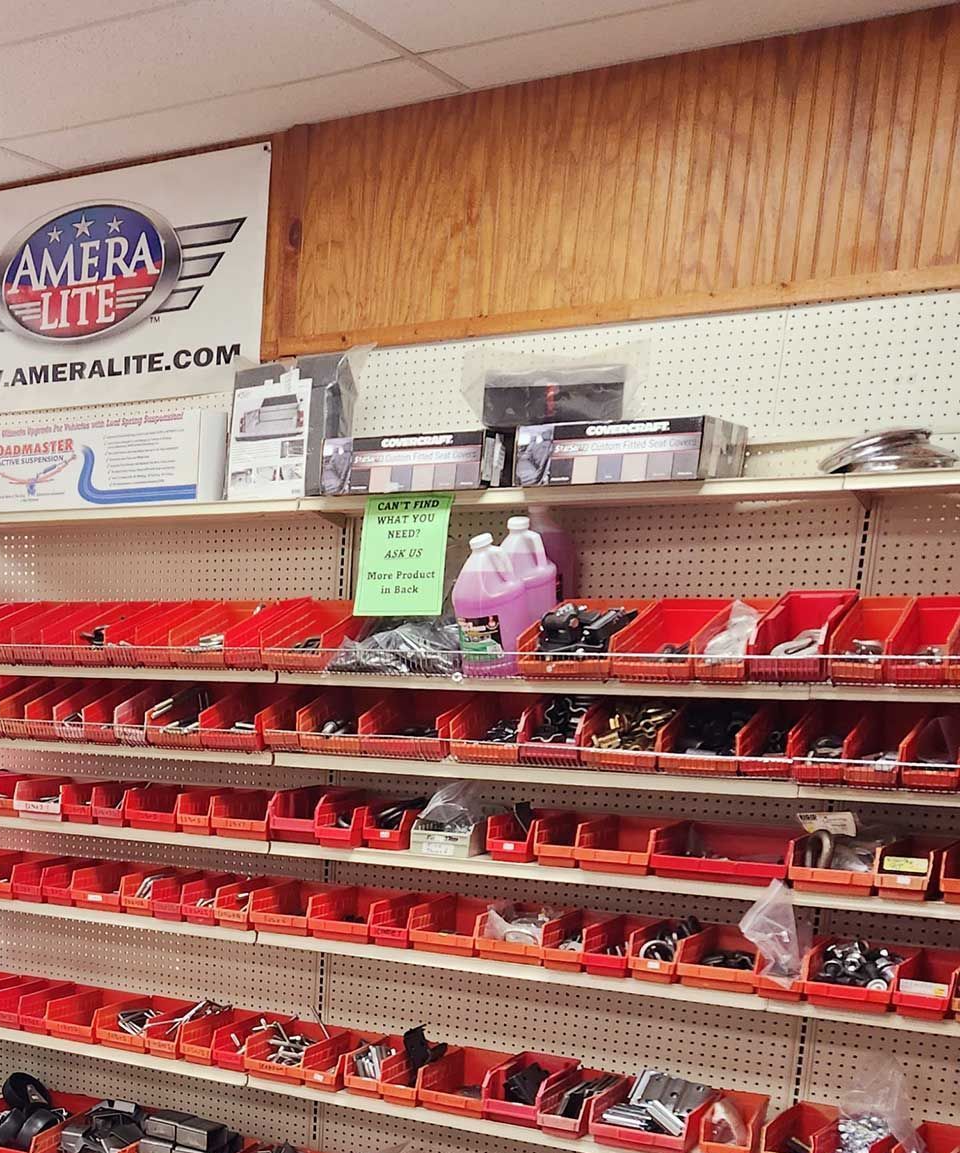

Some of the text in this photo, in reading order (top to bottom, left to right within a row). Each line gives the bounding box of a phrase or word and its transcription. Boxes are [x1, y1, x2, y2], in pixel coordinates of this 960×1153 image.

[7, 231, 160, 294] AMERA
[39, 283, 117, 331] LITE
[21, 455, 65, 466] SUSPENSION
[377, 499, 440, 511] CAN'T FIND
[377, 513, 436, 525] WHAT YOU
[387, 529, 421, 539] NEED?
[384, 548, 423, 559] ASK US
[367, 570, 436, 580] More Product
[381, 584, 419, 594] in Back
